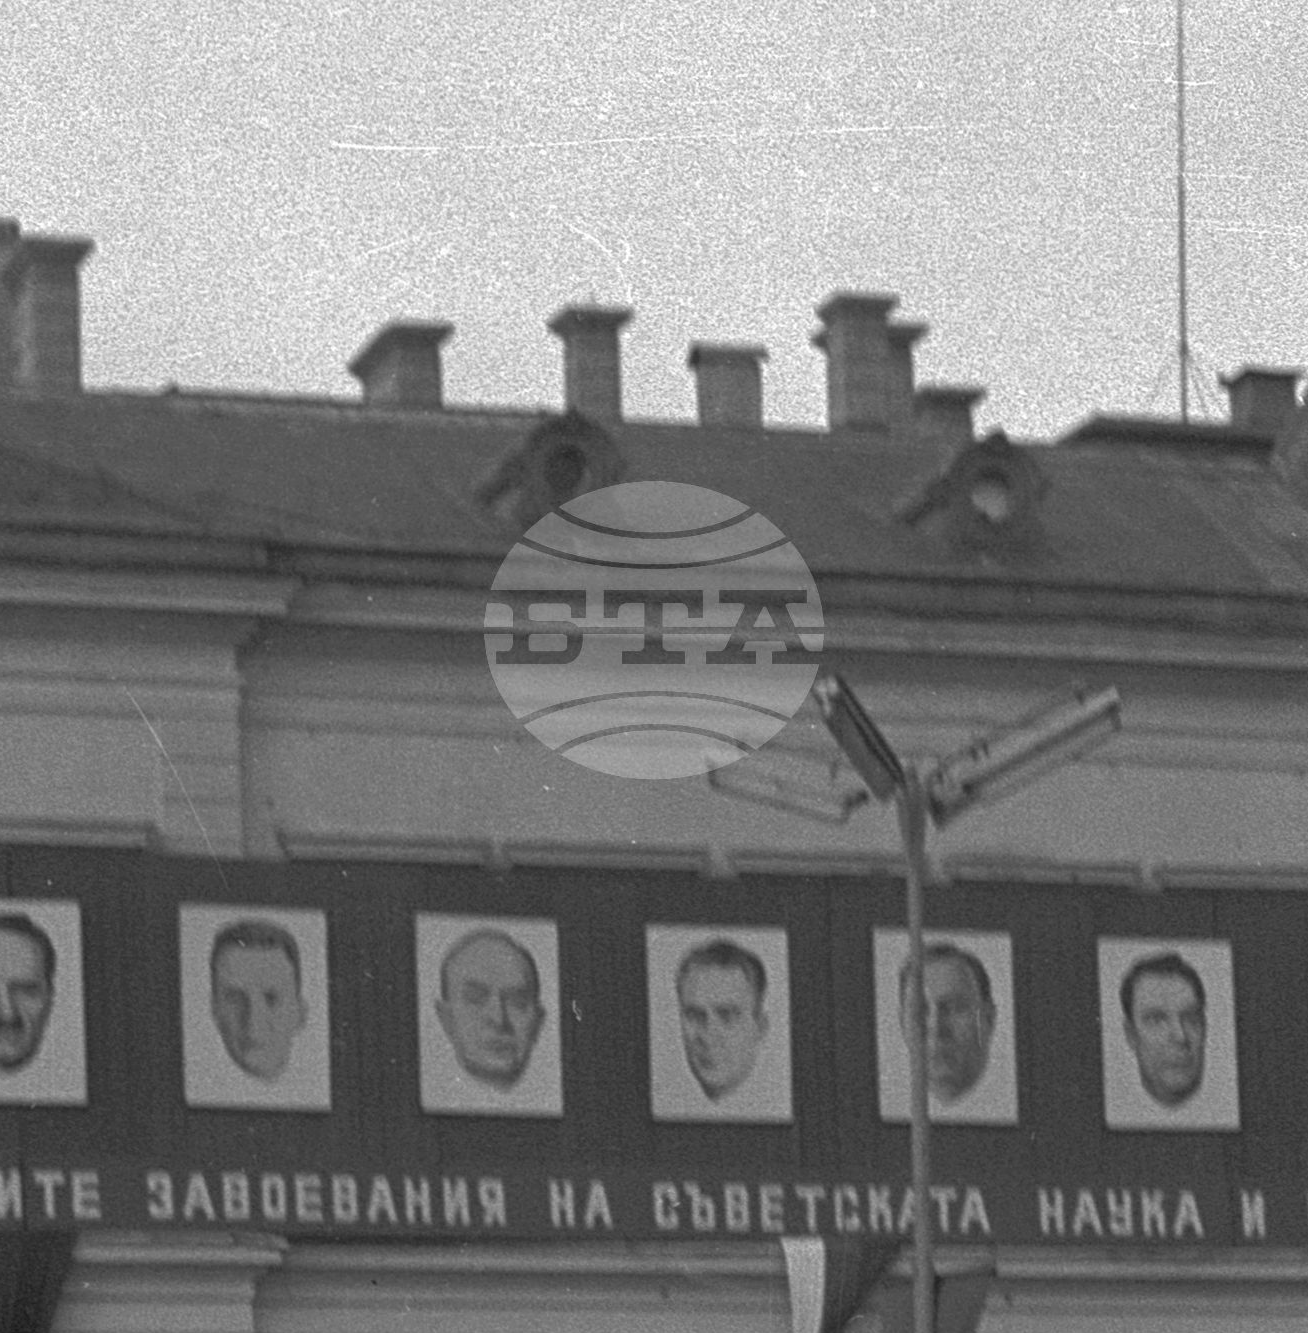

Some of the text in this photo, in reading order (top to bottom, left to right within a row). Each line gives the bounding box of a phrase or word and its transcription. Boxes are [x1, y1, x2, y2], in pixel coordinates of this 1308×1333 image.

[145, 1170, 508, 1227] ЗАВОЕВАНИЯ
[548, 1179, 614, 1229] НА
[651, 1181, 993, 1235] СЪВЕТСКАТА
[1037, 1188, 1205, 1238] НАУКА
[1239, 1190, 1267, 1238] И
